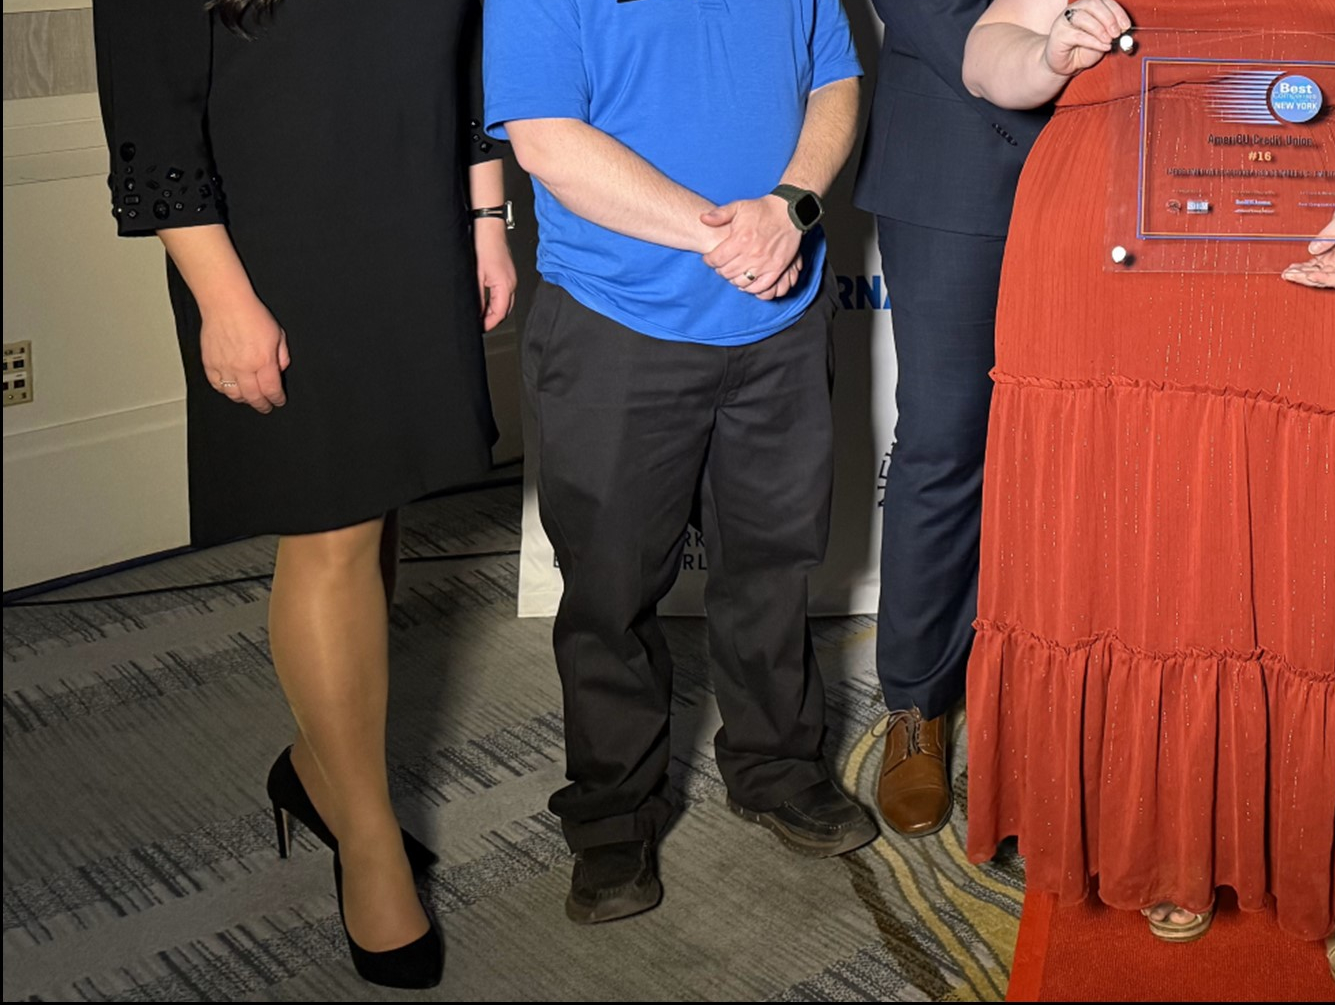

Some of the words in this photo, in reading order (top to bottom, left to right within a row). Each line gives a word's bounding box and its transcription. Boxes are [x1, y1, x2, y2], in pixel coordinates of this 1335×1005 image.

[1280, 82, 1312, 94] Best
[1274, 101, 1295, 110] NEW
[1296, 102, 1317, 110] YORK
[1248, 151, 1272, 161] #16
